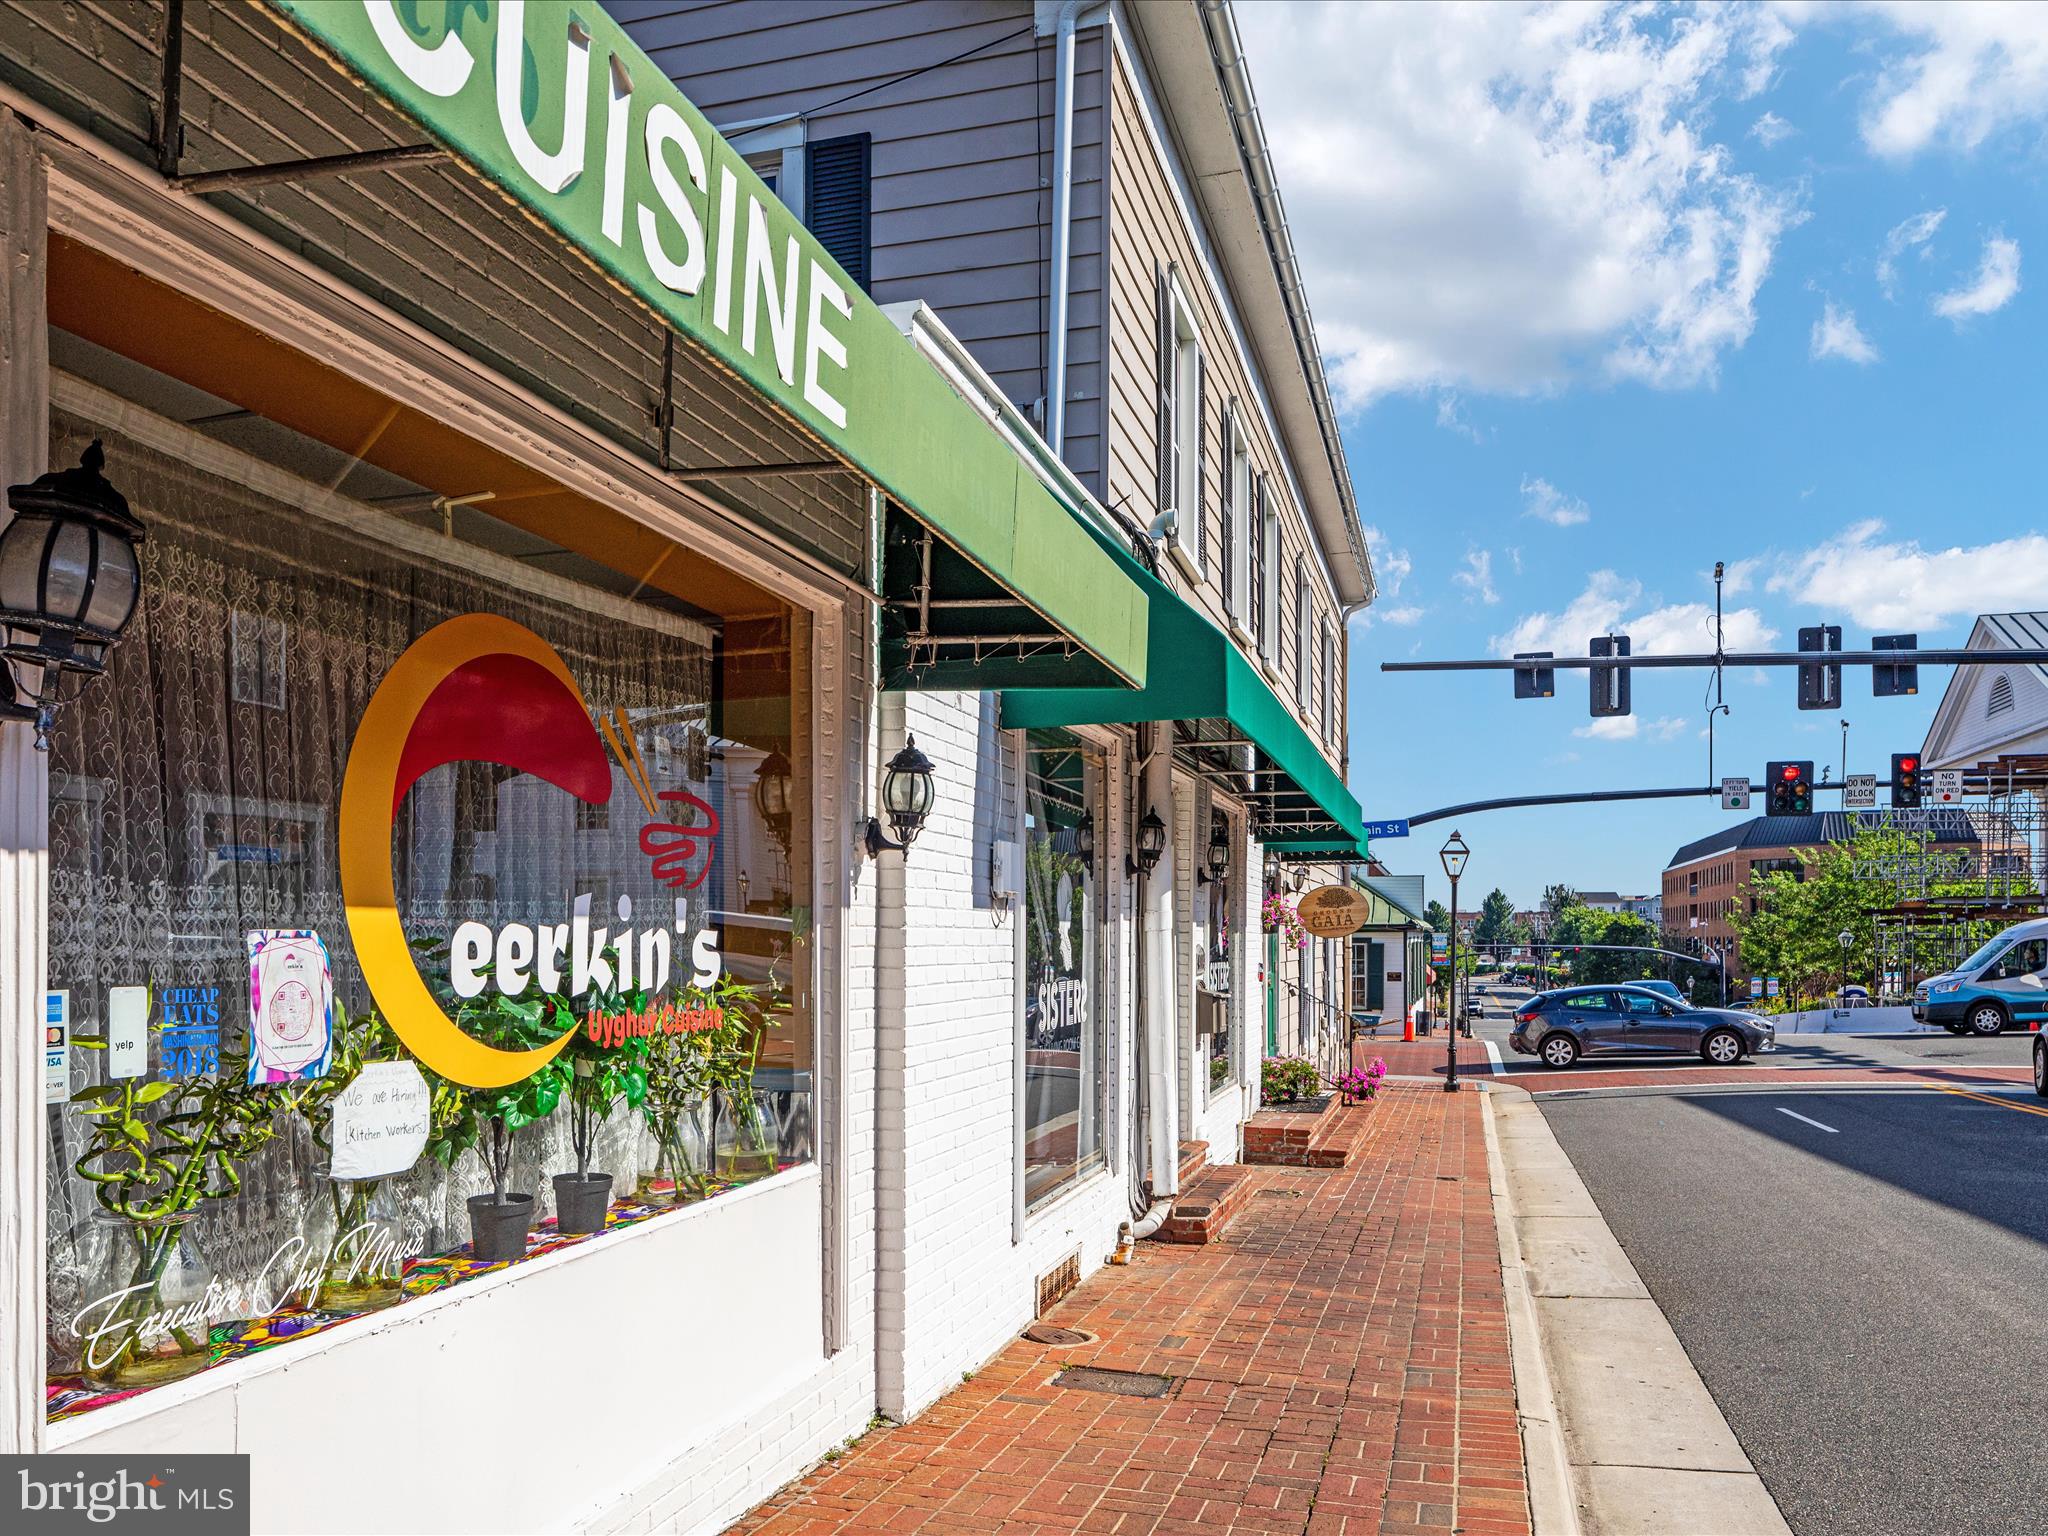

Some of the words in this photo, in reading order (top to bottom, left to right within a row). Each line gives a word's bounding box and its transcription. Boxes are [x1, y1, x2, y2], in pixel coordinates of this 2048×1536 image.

[1848, 778, 1858, 787] DO
[1860, 778, 1874, 787] NOT
[1941, 772, 1955, 780] NO
[1848, 789, 1874, 798] BLOCK
[1367, 825, 1381, 834] ain
[1386, 823, 1399, 833] St
[1312, 913, 1354, 928] GAIA
[162, 988, 220, 1004] CHEAP
[1038, 978, 1088, 1033] SISTERS
[163, 1003, 219, 1025] EATS
[588, 1007, 657, 1049] Uyghur
[662, 1000, 724, 1036] Cuisine
[115, 1040, 134, 1051] yelp
[46, 1057, 62, 1067] ISA
[159, 1047, 220, 1079] 2018
[342, 1086, 363, 1107] We
[372, 1090, 387, 1105] are
[71, 1273, 243, 1370] Executive
[253, 1236, 333, 1318] Chef
[333, 1222, 424, 1283] Musa
